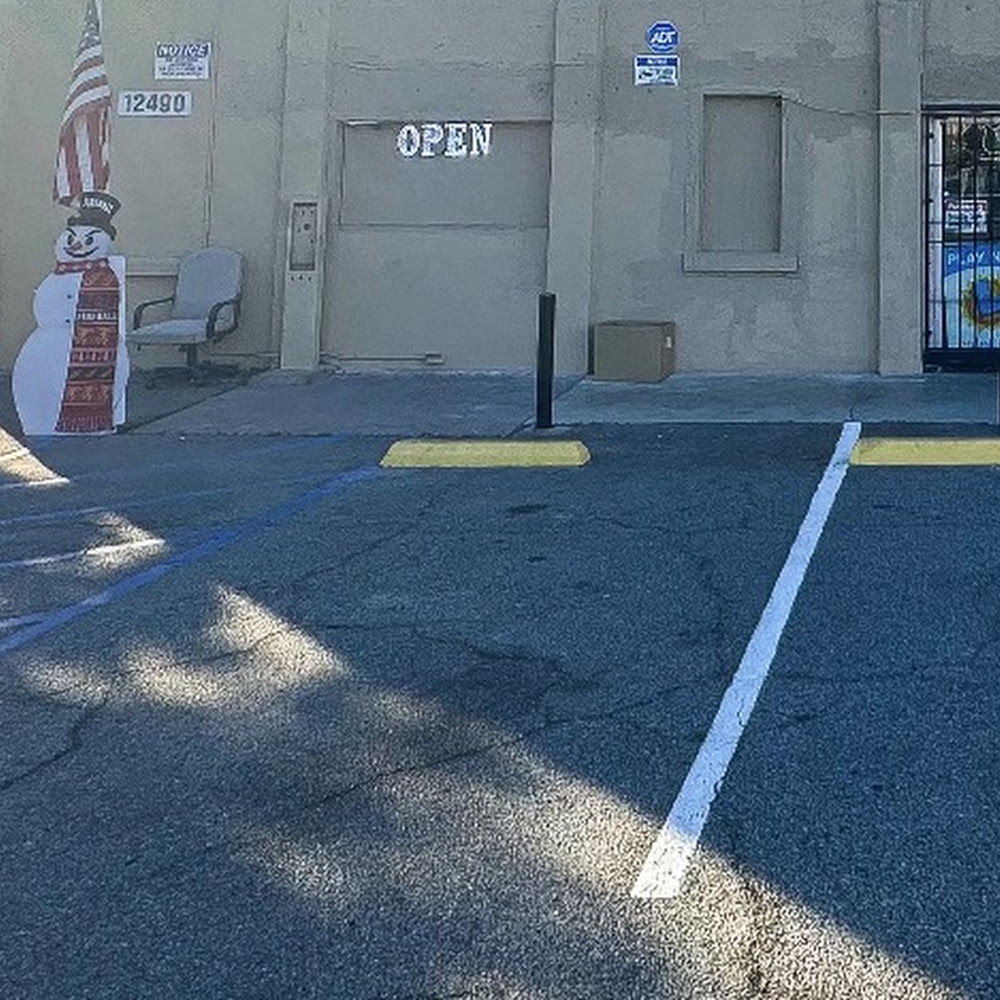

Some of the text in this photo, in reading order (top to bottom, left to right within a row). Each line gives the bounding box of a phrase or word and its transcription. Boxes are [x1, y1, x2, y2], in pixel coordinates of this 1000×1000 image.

[650, 31, 676, 44] ADT
[124, 93, 186, 113] 12490
[397, 122, 494, 157] OPEN
